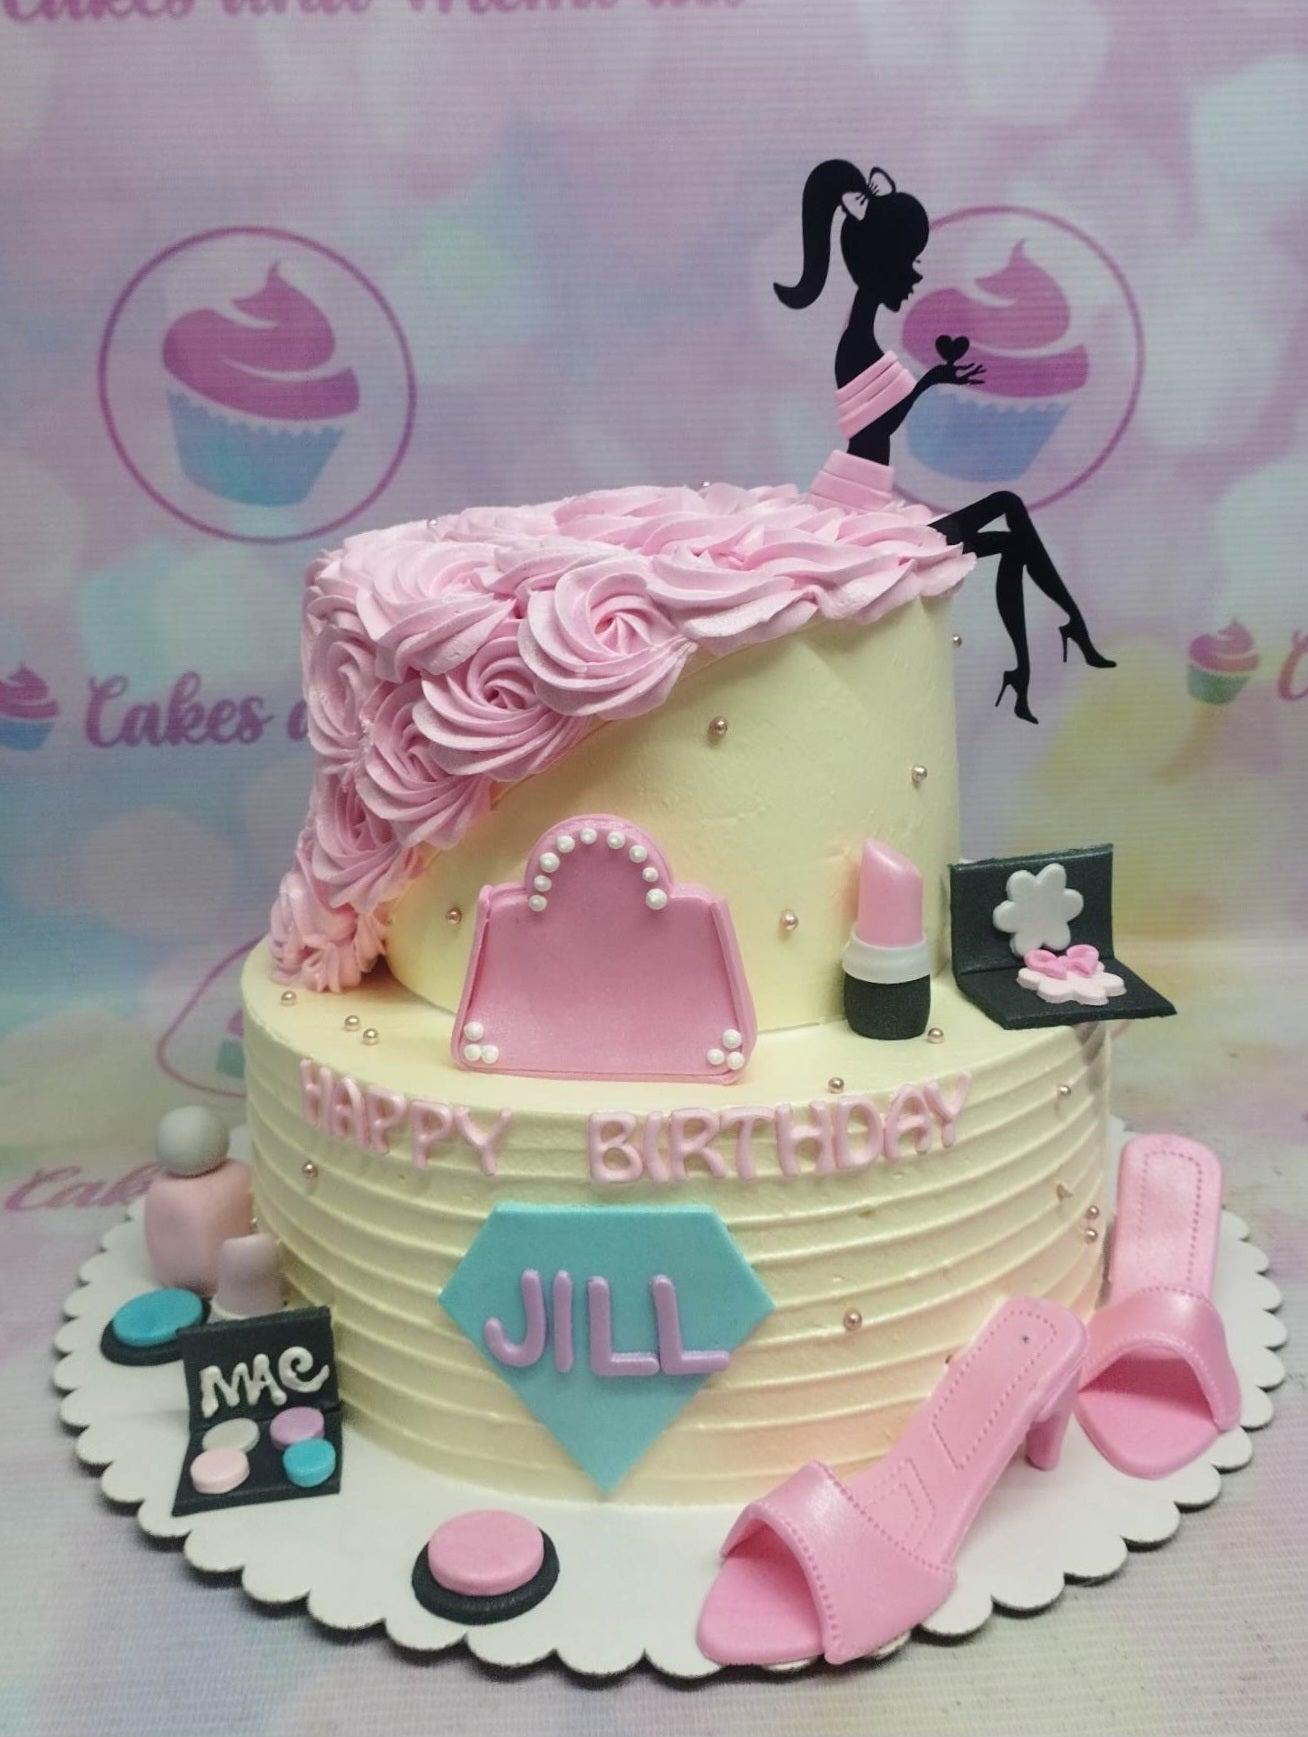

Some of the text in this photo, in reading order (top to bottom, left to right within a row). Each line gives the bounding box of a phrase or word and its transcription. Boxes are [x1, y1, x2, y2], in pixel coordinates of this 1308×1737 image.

[84, 670, 274, 749] Cakes
[299, 1057, 973, 1184] HAPPY BIRTHDAY
[483, 1267, 731, 1377] JILL
[200, 1346, 330, 1418] MAC
